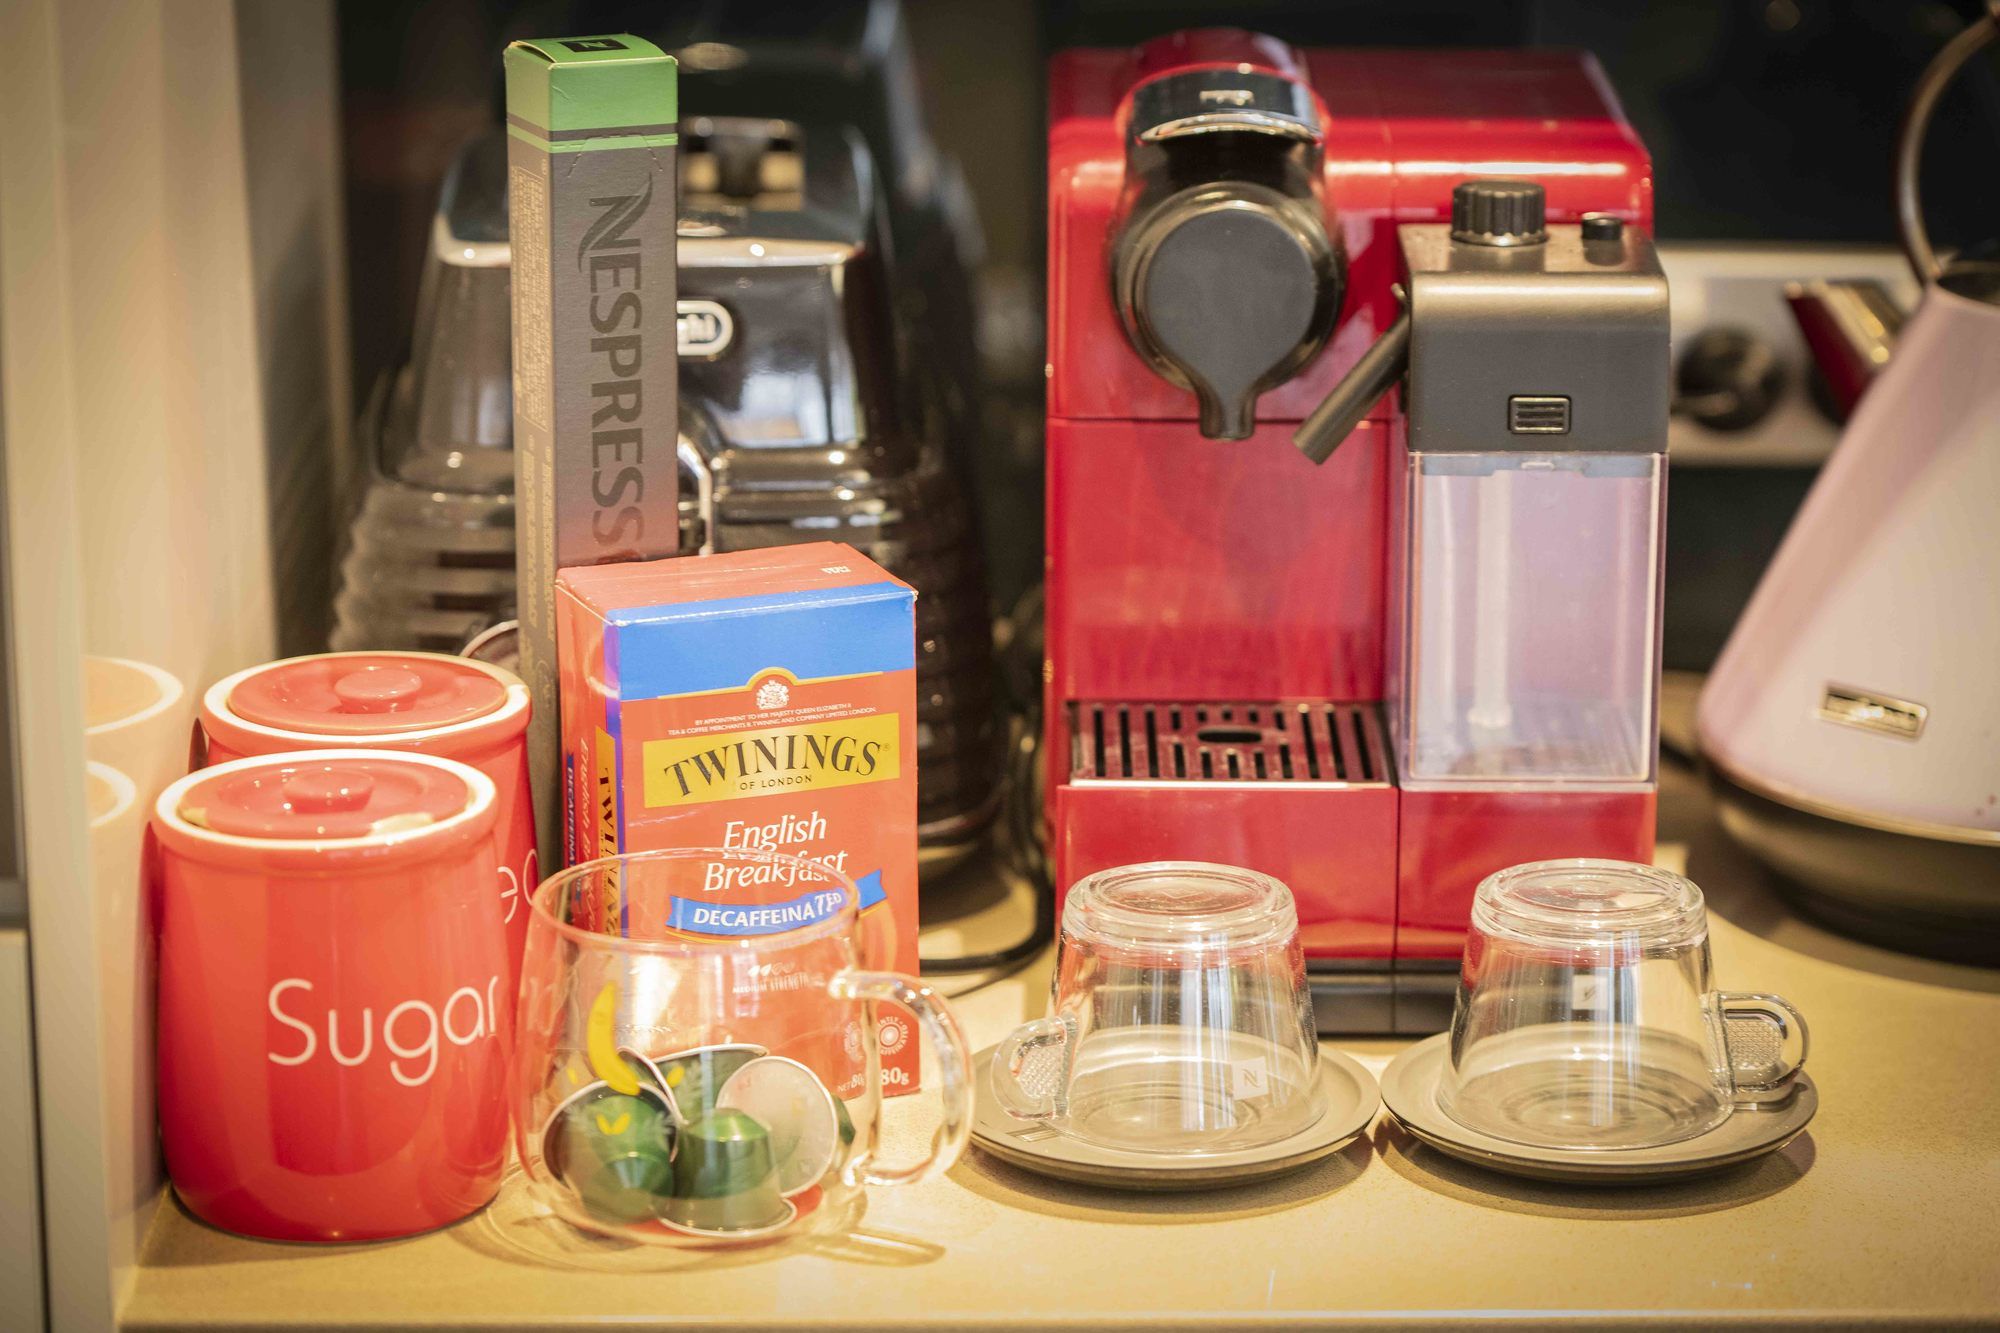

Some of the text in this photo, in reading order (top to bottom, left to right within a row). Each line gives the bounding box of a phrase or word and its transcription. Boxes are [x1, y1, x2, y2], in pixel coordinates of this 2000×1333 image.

[577, 171, 654, 561] NESPRESS
[686, 726, 709, 734] COFFEE
[703, 715, 746, 725] APPOINTMENT
[795, 707, 816, 715] QUEEN
[664, 734, 880, 796] TWININGS
[739, 774, 813, 791] OF LONDON
[723, 810, 827, 852] English
[703, 850, 848, 891] Breakfast
[693, 892, 843, 927] DECAFFEINATED
[268, 975, 498, 1087] Sugar
